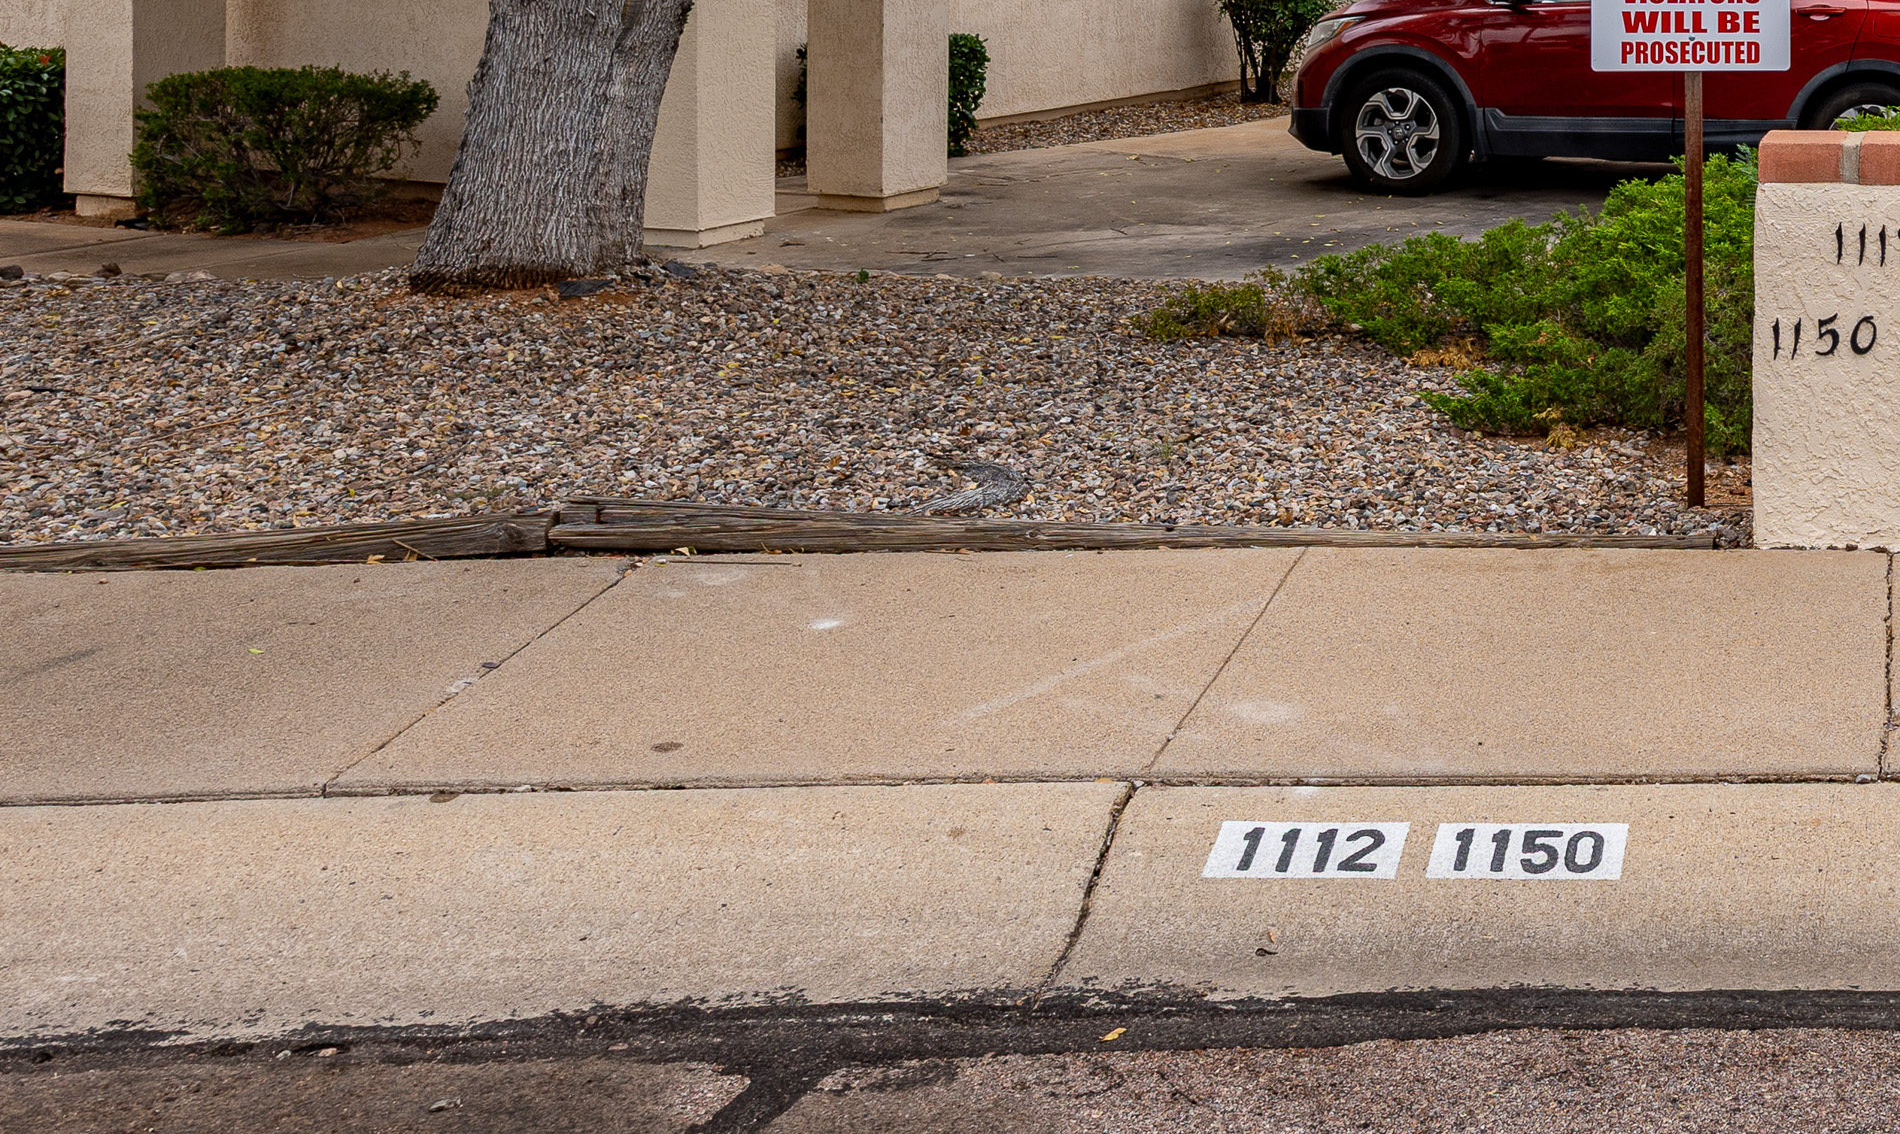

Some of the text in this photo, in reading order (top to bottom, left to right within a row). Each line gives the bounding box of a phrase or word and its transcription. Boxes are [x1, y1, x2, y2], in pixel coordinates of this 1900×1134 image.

[1622, 11, 1760, 34] WILL BE
[1621, 41, 1760, 64] PROSECUTED
[1772, 313, 1878, 361] 1150
[1236, 827, 1605, 874] 1112 1150
